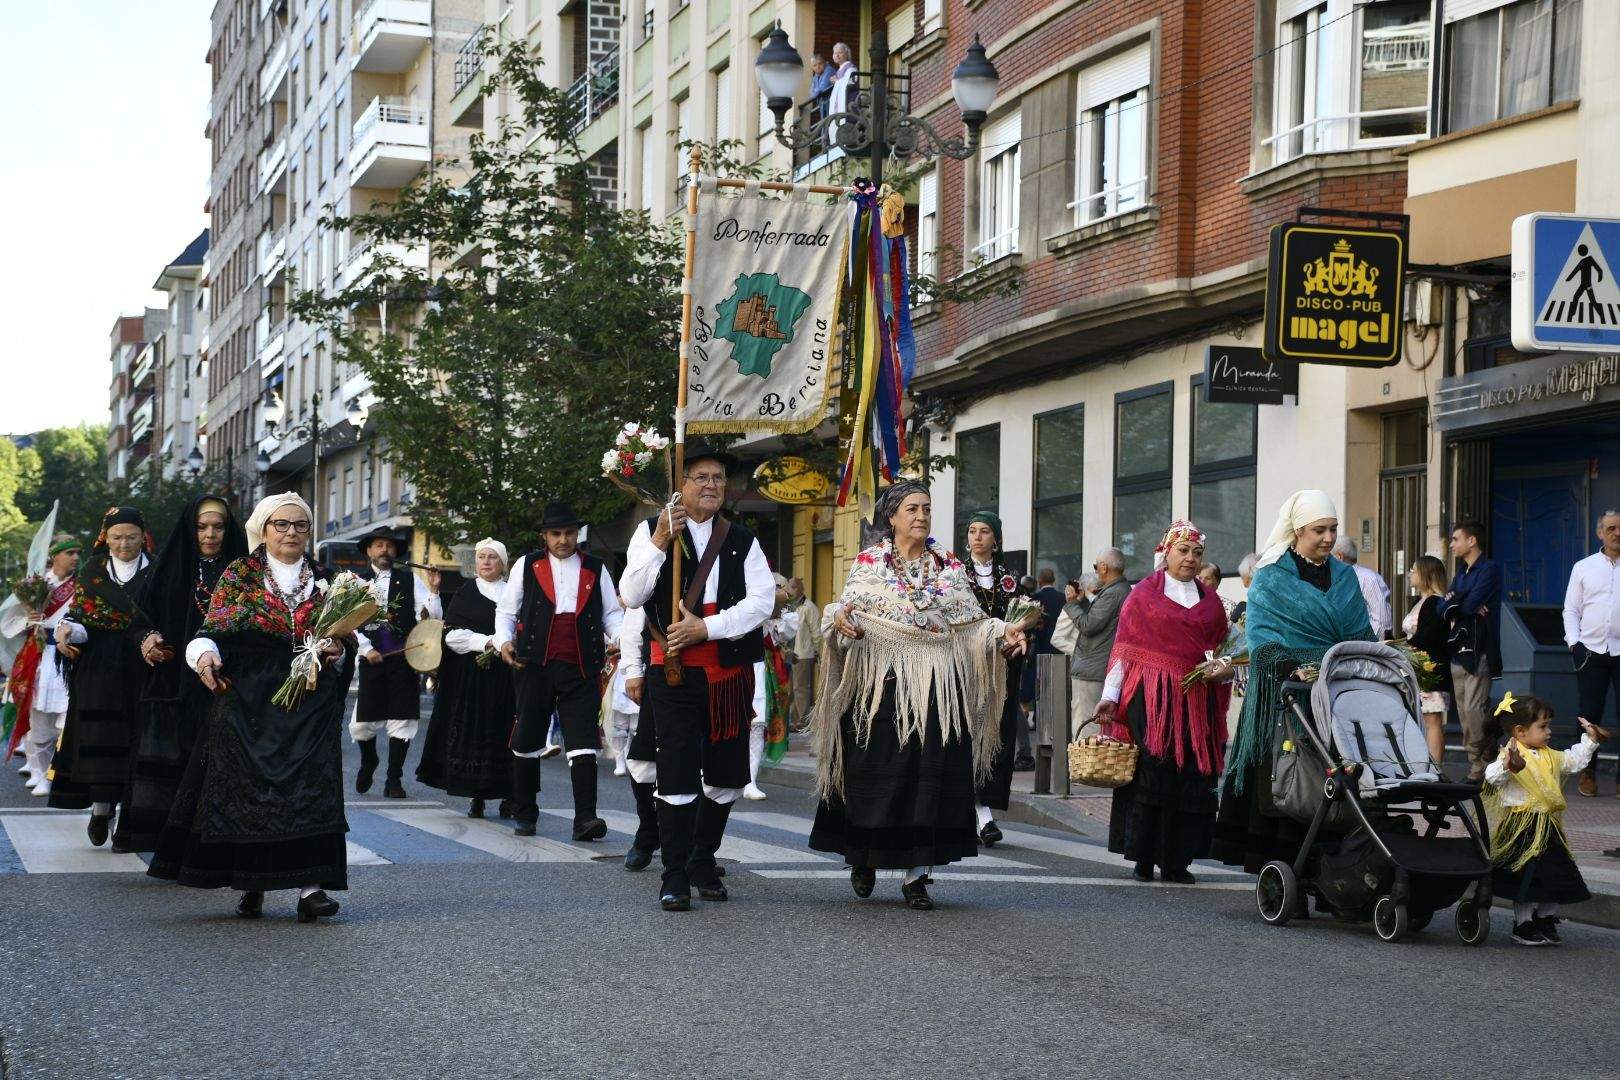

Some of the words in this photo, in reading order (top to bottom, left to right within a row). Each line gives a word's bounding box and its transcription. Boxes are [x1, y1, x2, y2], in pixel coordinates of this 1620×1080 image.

[713, 218, 830, 254] Ponferrada
[1290, 313, 1390, 350] magel
[758, 317, 828, 416] Berciana
[1211, 354, 1280, 384] Miranda
[1480, 386, 1516, 409] DISCO
